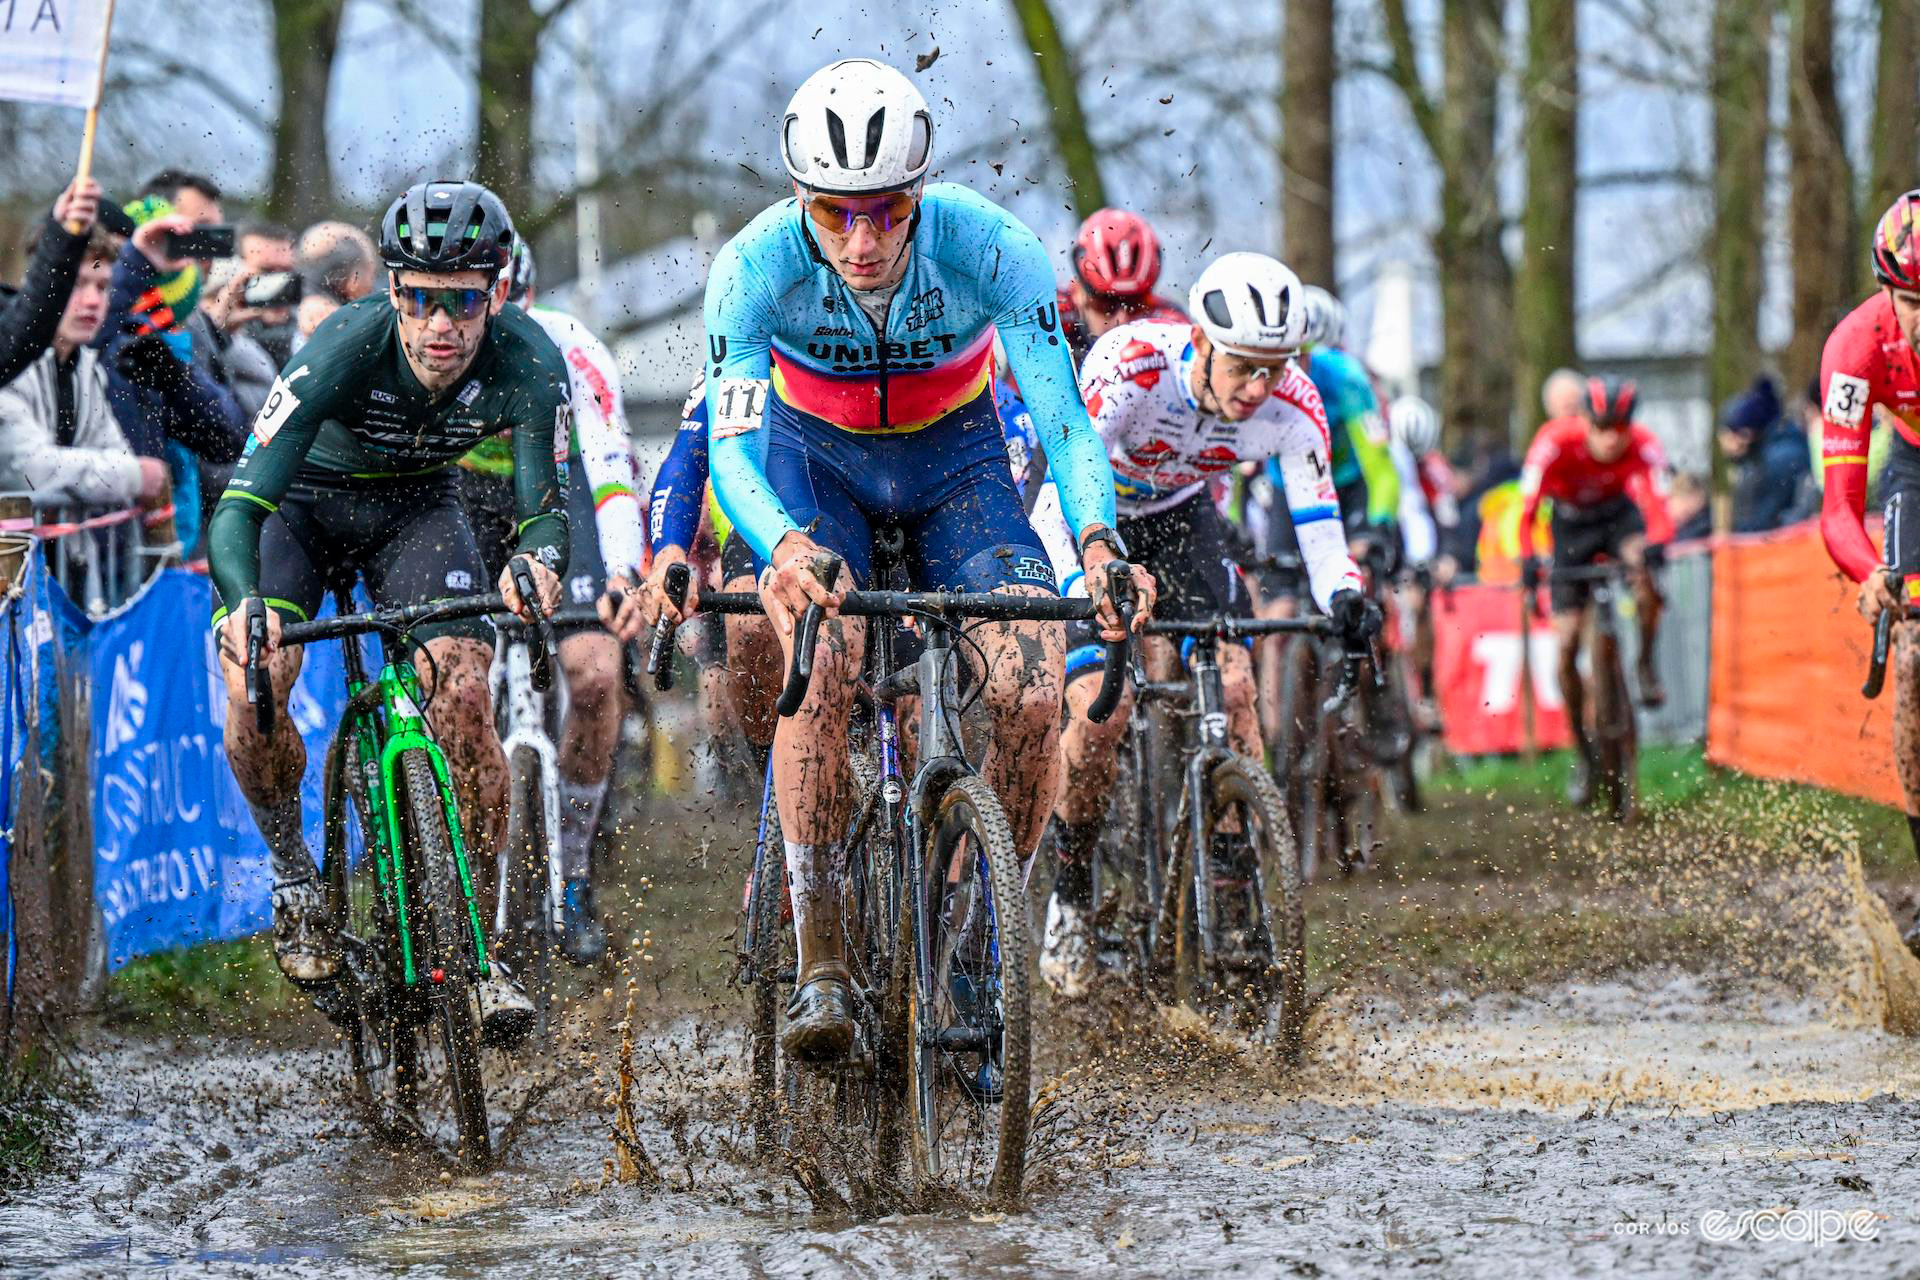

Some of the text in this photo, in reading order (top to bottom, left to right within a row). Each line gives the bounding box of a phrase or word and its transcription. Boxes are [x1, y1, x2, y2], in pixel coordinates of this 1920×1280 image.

[807, 334, 956, 363] UNIBET
[263, 391, 283, 420] 9
[723, 386, 759, 418] 11
[1838, 384, 1856, 411] 3
[650, 486, 673, 545] TREK
